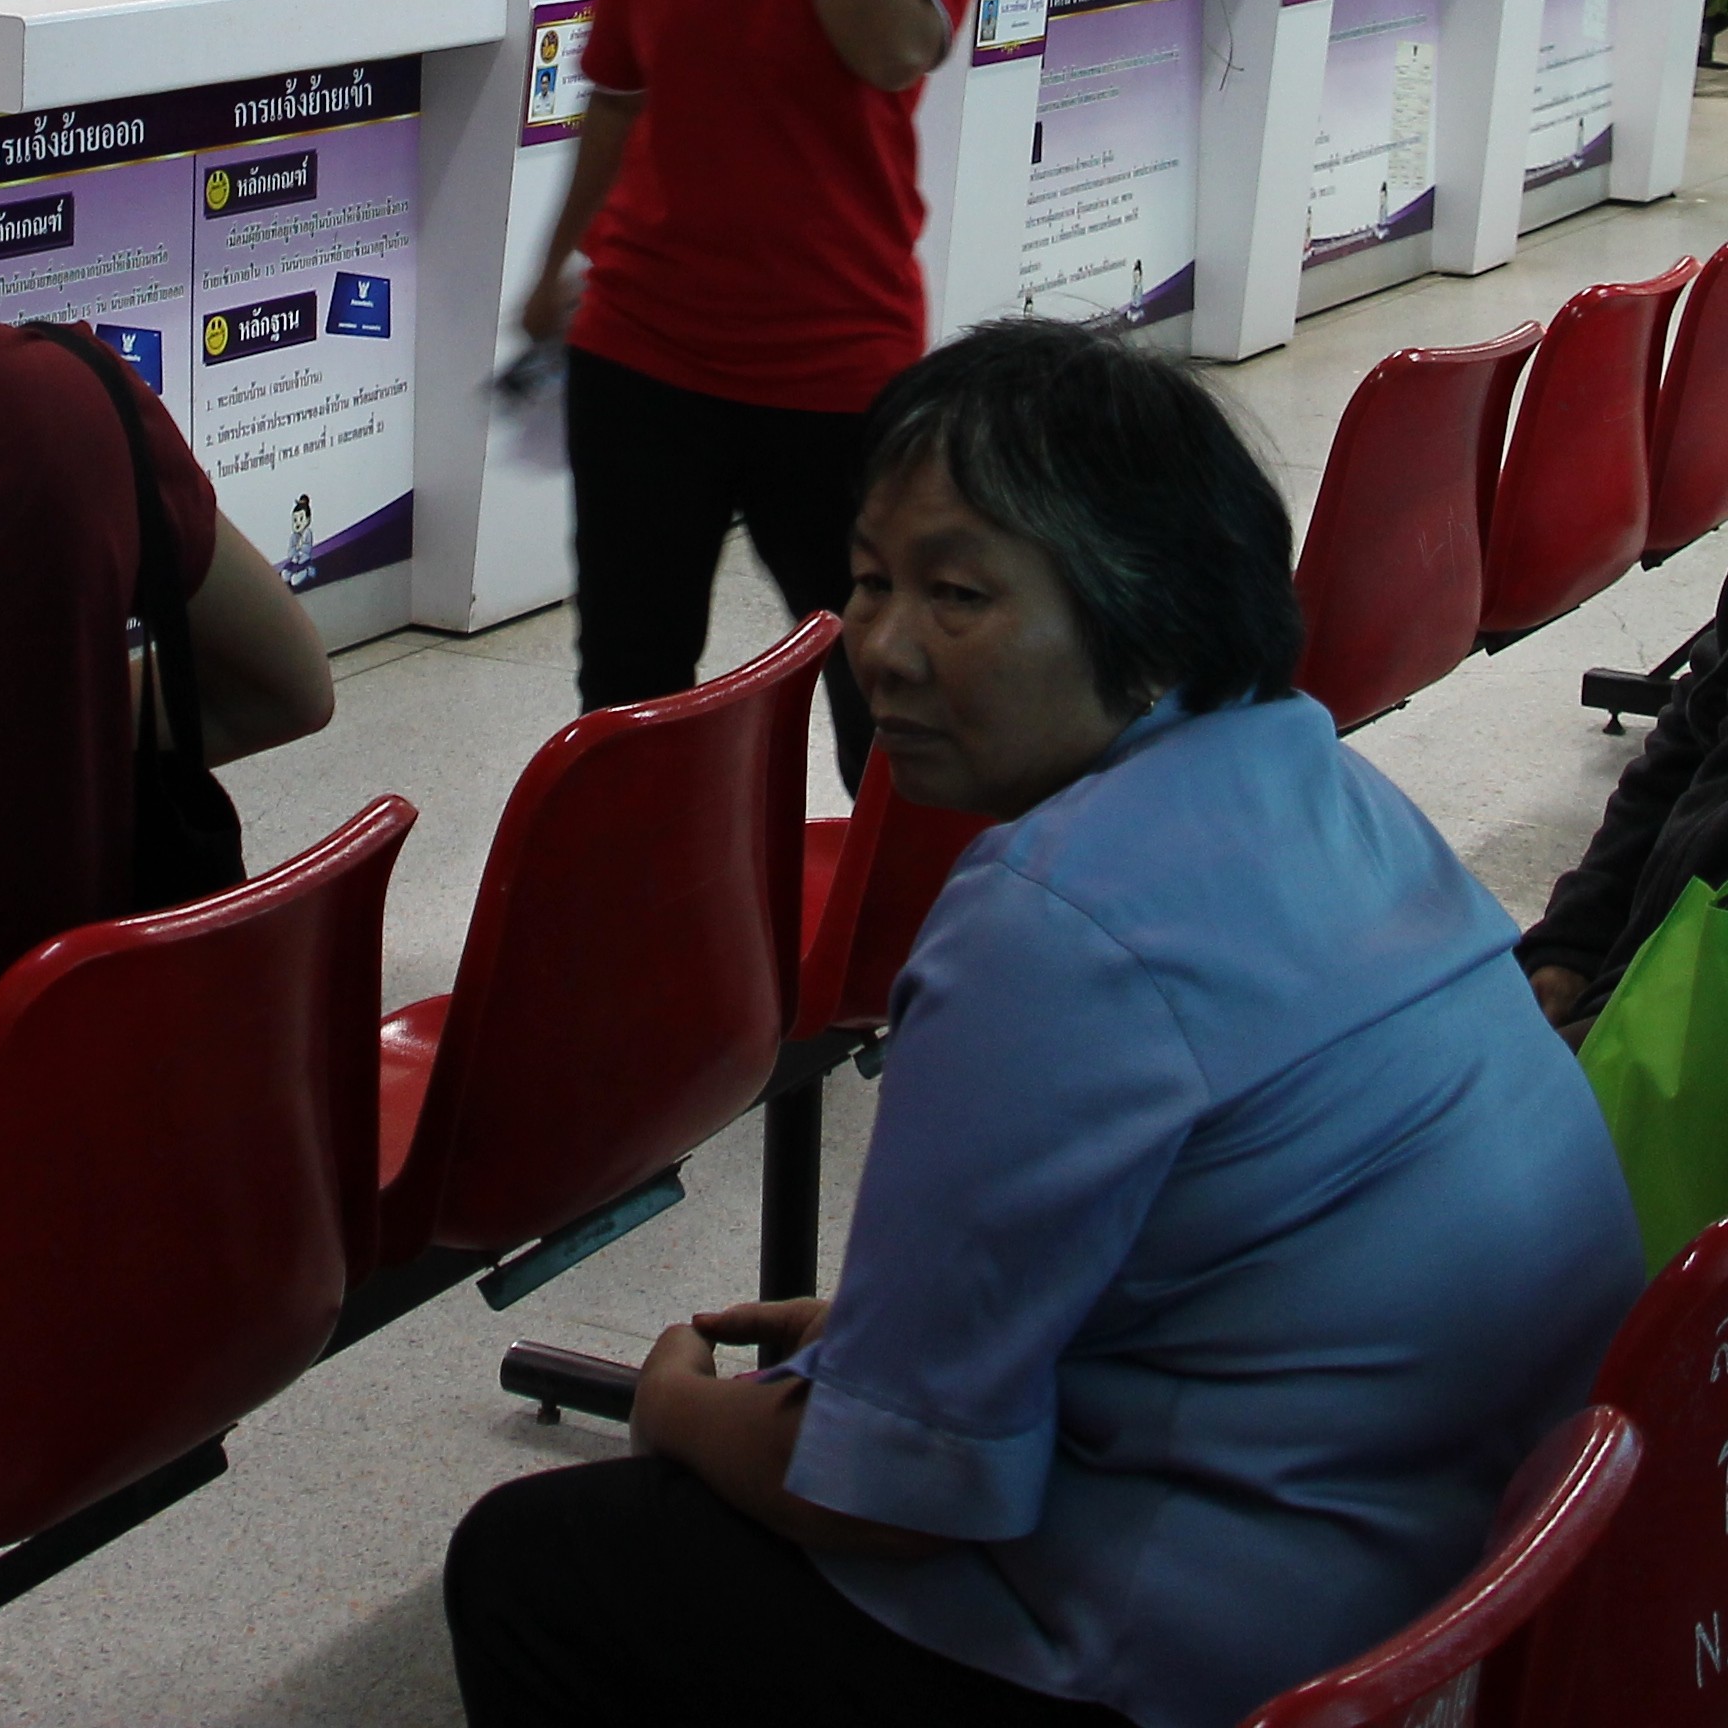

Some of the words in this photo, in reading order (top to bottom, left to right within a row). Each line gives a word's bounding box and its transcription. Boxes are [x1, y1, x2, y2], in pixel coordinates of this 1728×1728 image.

[233, 68, 374, 124] การแจ้งย้ายเข้า
[237, 154, 309, 200] หลักเกณฑ์
[239, 307, 300, 342] หลักฐาน
